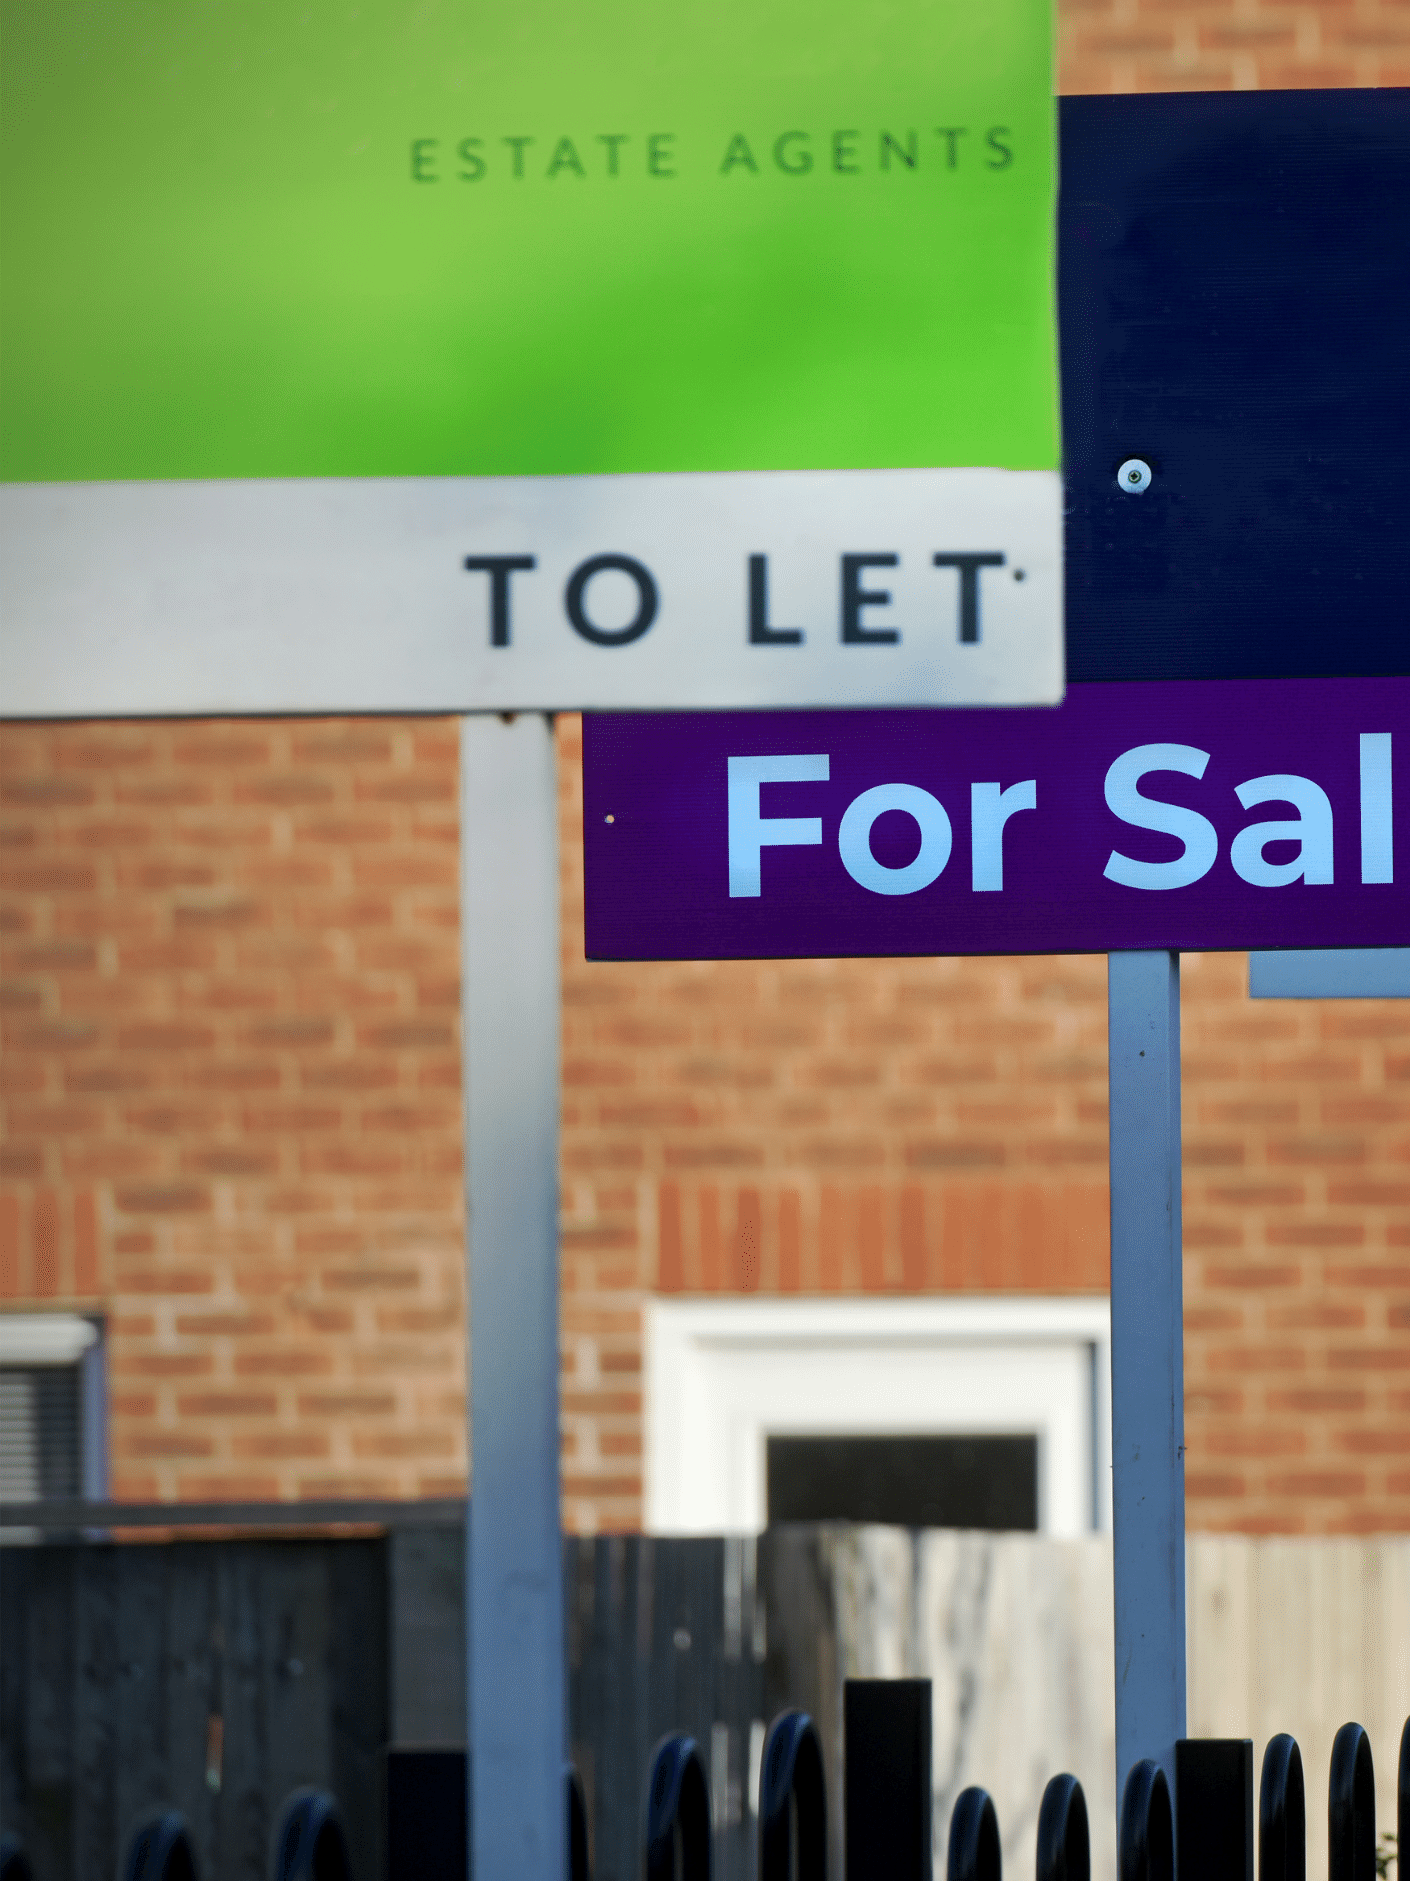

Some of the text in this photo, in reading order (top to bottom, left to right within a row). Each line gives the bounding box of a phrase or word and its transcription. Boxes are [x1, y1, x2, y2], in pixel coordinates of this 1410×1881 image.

[409, 125, 1018, 184] ESTATE AGENTS
[463, 551, 1007, 649] TO LET
[726, 752, 1038, 899] For
